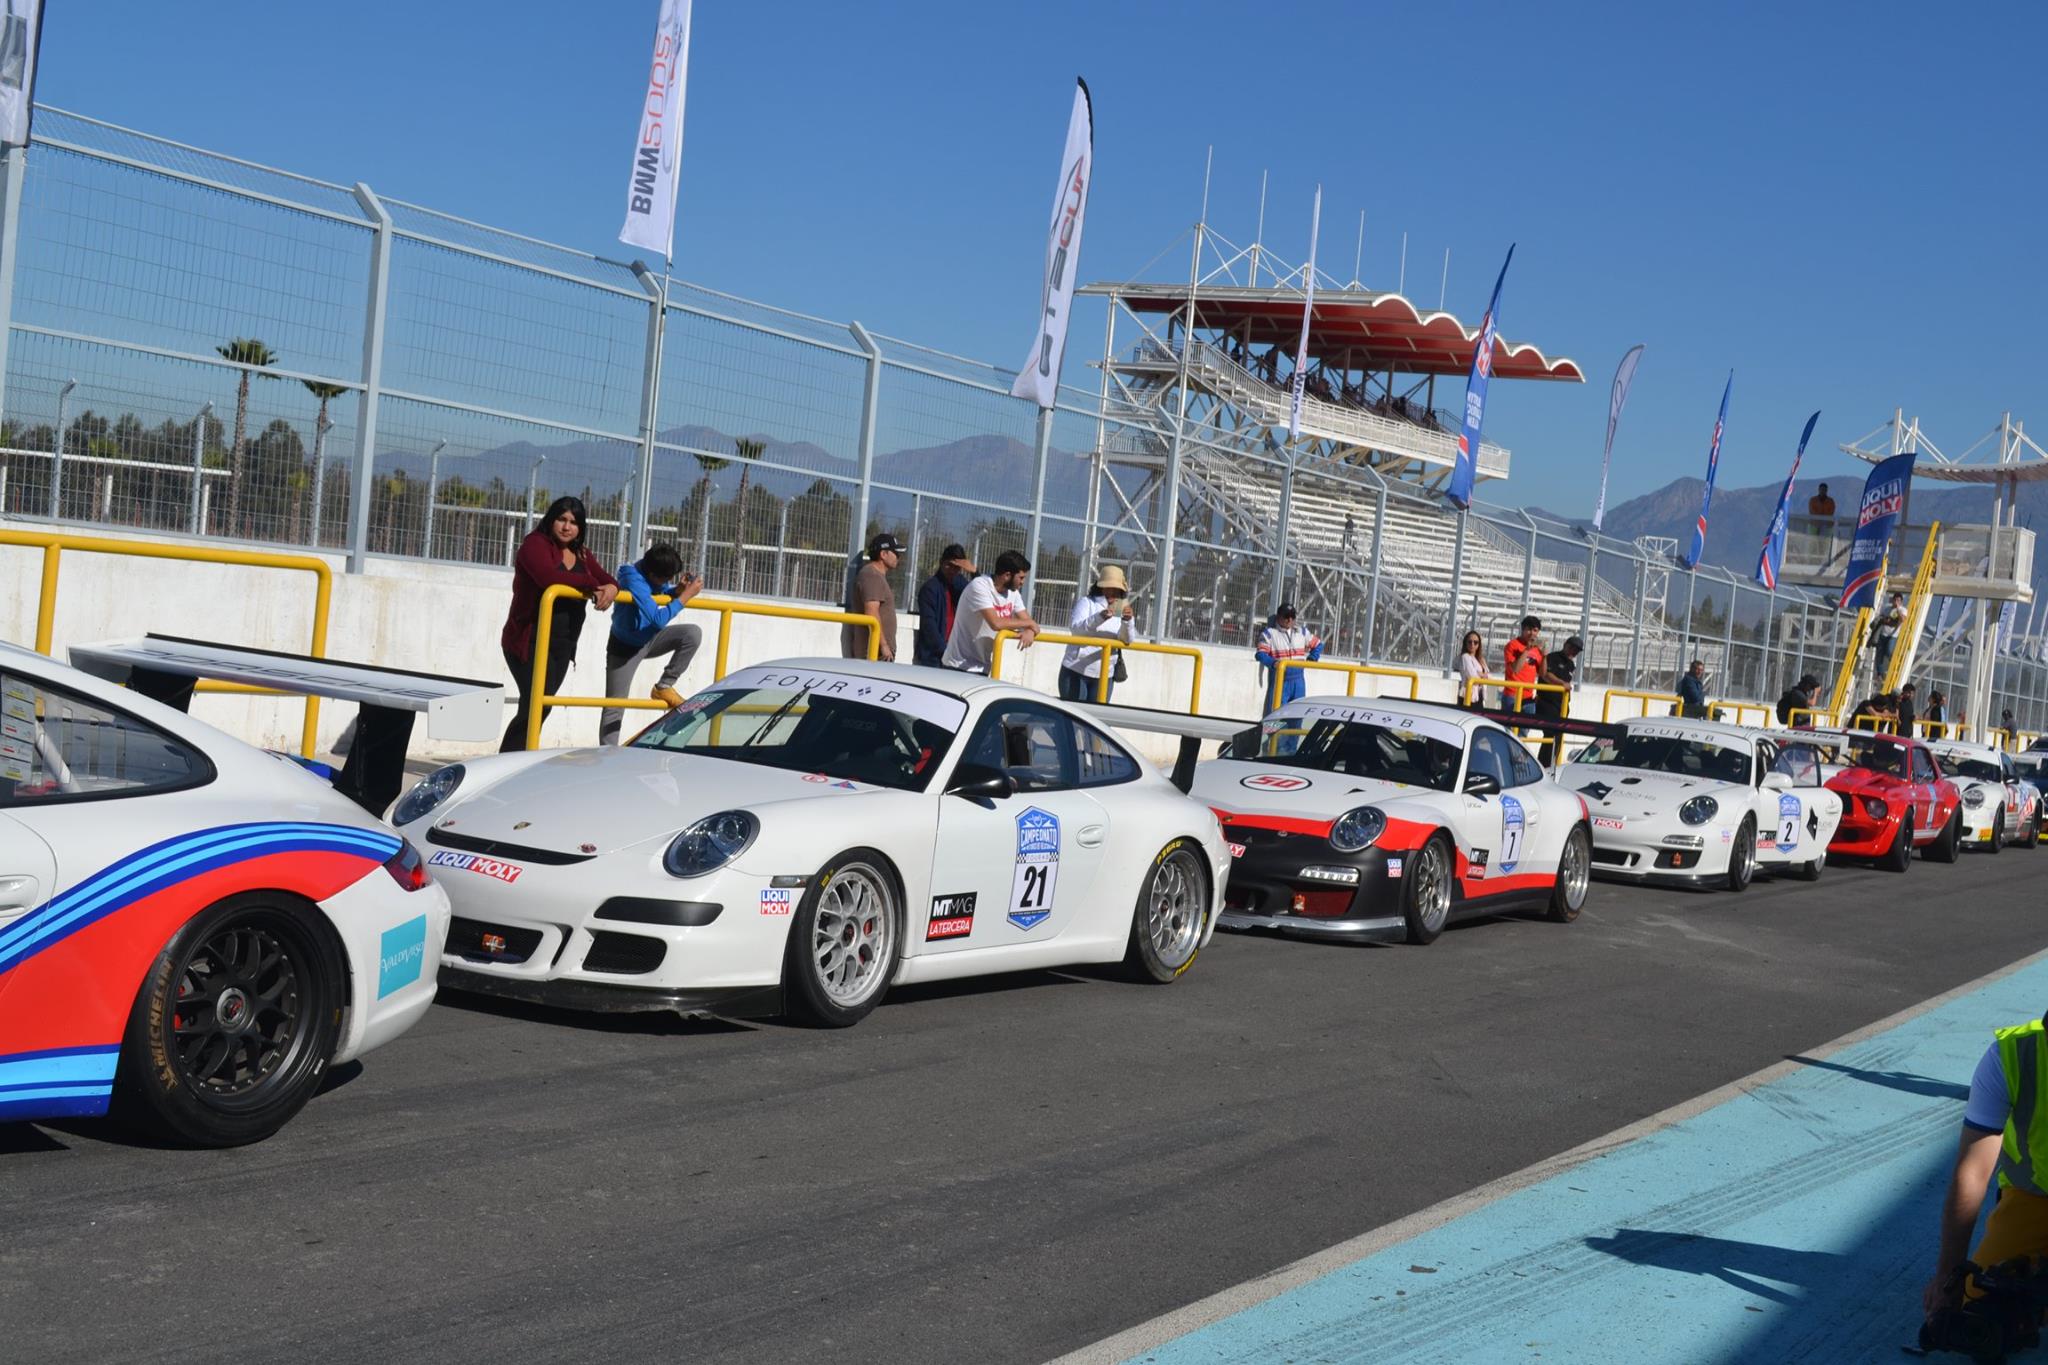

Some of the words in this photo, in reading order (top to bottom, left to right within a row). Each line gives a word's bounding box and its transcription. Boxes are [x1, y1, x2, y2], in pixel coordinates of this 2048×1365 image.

[1859, 496, 1900, 524] MOLY
[757, 674, 848, 693] FOUR
[879, 690, 901, 703] B
[1304, 707, 1373, 721] FOUR
[1400, 718, 1414, 728] B
[1632, 726, 1685, 737] FOUR
[1704, 734, 1715, 742] B
[1247, 775, 1305, 789] 50
[1596, 818, 1624, 830] MOLY
[1783, 821, 1793, 842] 2
[1020, 828, 1058, 848] CAMPEONATO
[430, 851, 473, 869] LIQUI
[471, 858, 522, 882] MOLY
[761, 890, 789, 902] LIQUI
[1019, 865, 1048, 908] 21
[761, 902, 789, 915] MOLY
